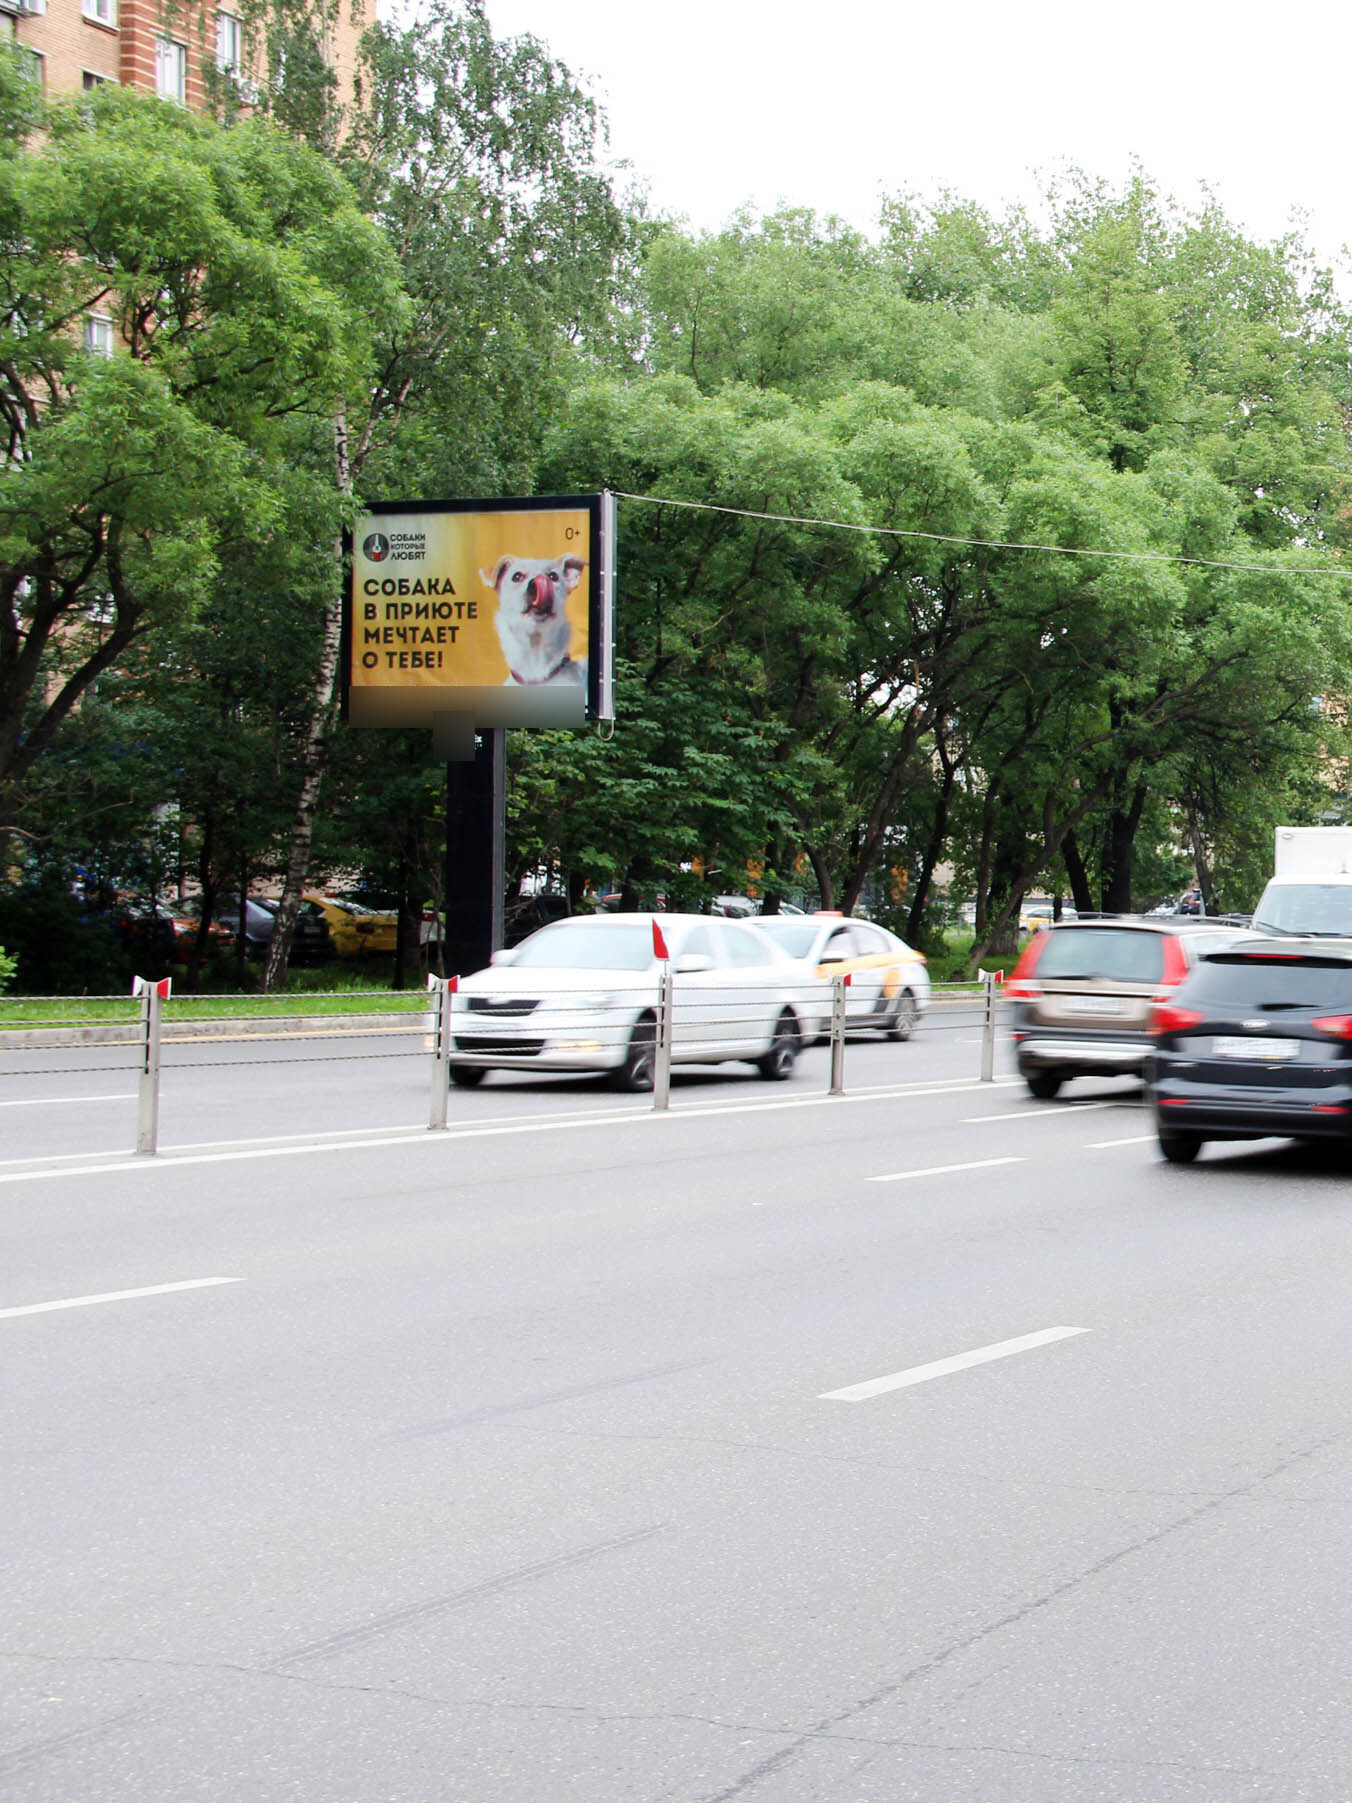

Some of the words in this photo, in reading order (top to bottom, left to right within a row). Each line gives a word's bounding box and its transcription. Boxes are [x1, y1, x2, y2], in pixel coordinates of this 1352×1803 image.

[390, 534, 426, 542] СОБАКИ
[565, 527, 580, 540] 0+
[391, 551, 426, 560] ЛЮБЯТ
[364, 578, 456, 596] СОБАКА
[364, 602, 378, 620] В
[385, 601, 478, 620] ПРИЮТЕ
[364, 626, 459, 644] МЕЧТАЕТ
[362, 651, 378, 668] О
[385, 650, 443, 669] ТЕБЕ!
